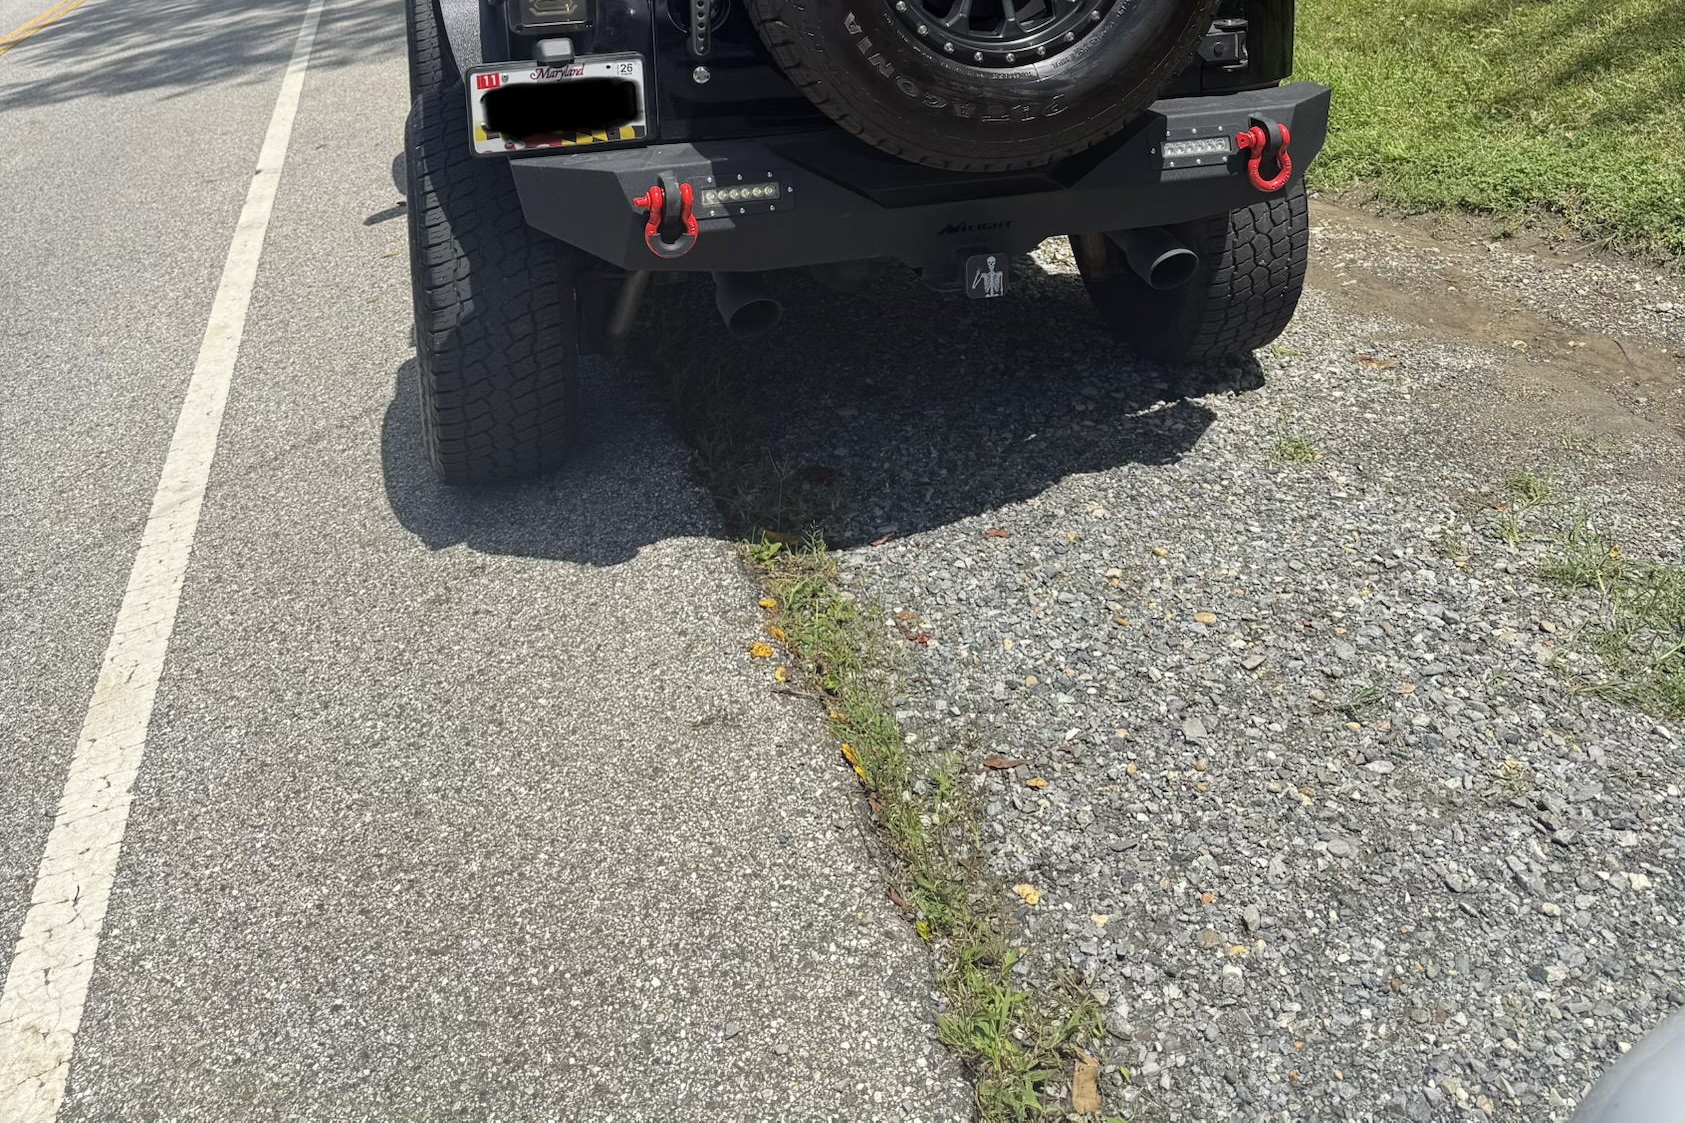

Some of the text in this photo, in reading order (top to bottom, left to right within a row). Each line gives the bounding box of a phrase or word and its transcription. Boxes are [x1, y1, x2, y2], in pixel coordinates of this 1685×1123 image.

[484, 74, 496, 86] 11
[530, 63, 585, 82] Maryland
[620, 63, 633, 73] 26
